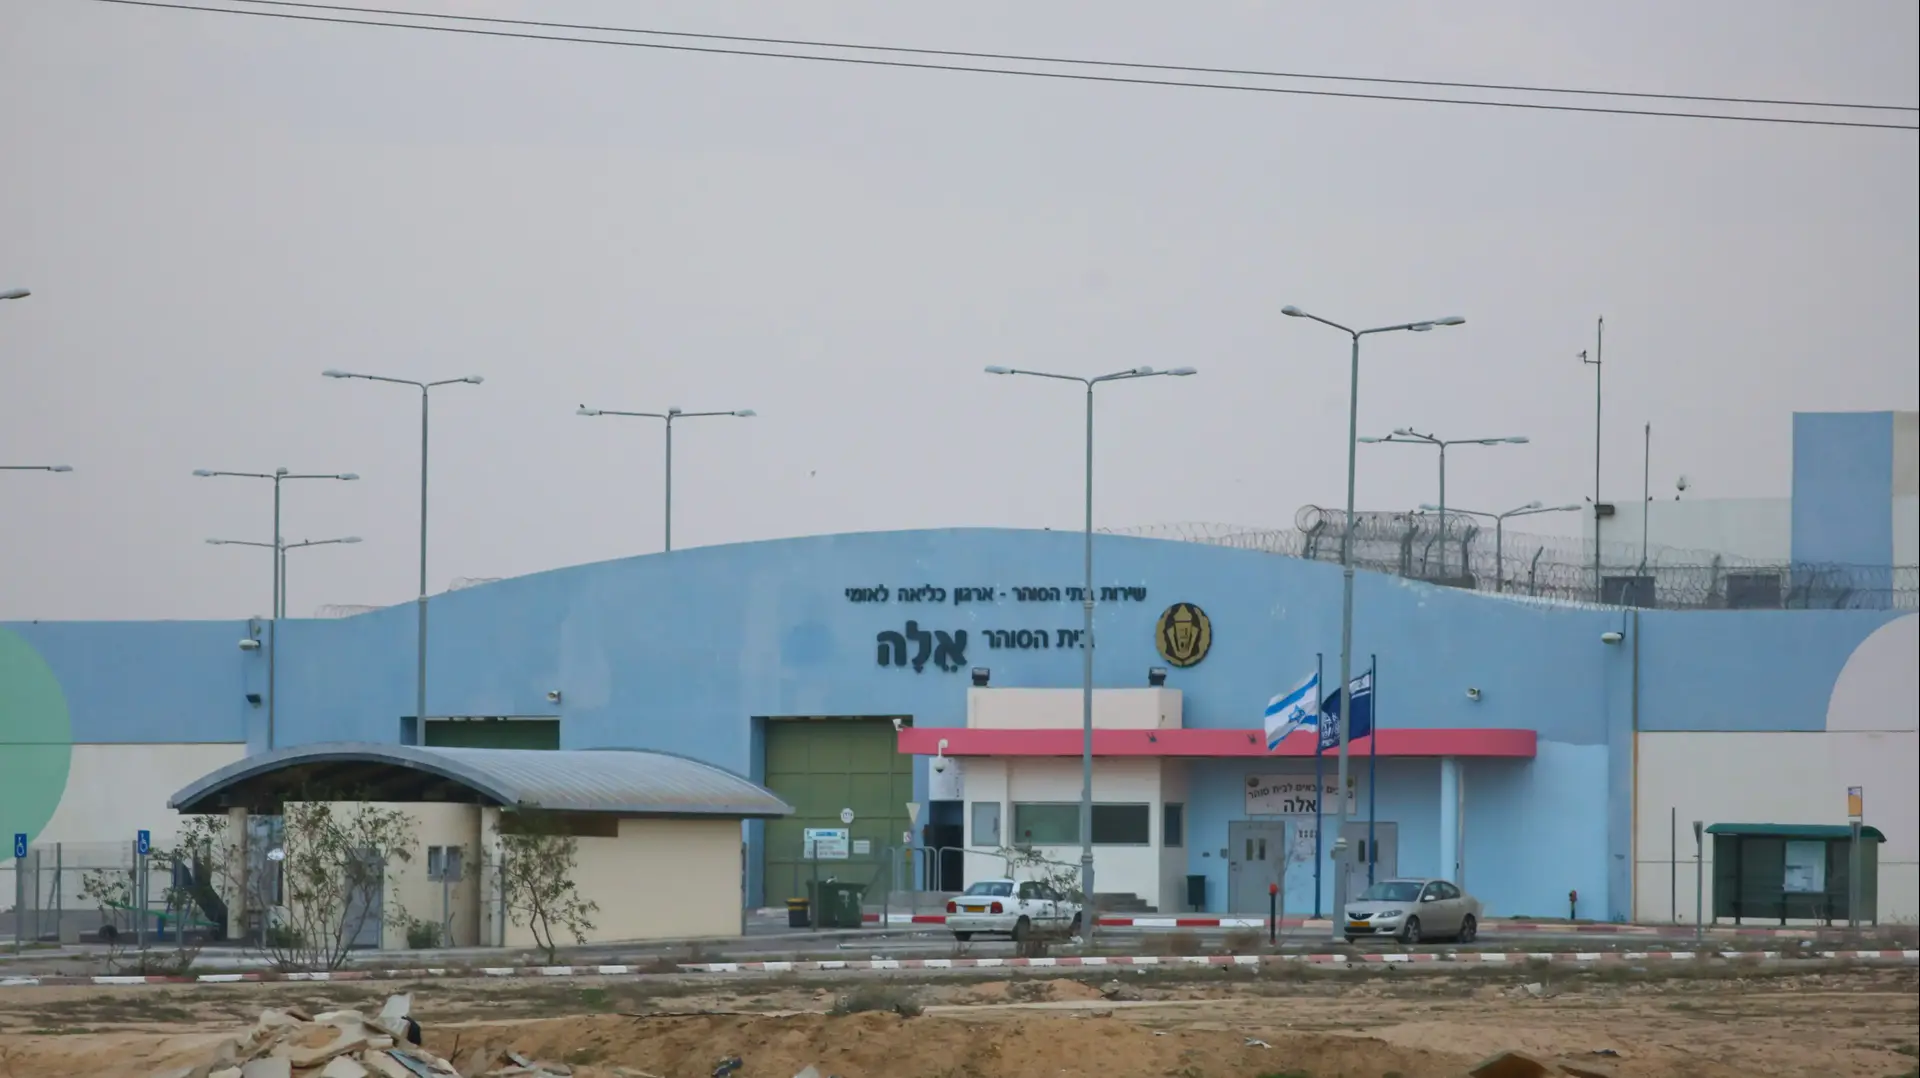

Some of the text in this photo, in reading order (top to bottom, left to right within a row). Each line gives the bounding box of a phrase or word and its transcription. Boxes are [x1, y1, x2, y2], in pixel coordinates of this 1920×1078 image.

[844, 583, 890, 602] לאומי
[897, 583, 947, 602] כליאה
[953, 586, 994, 606] ארגון
[1011, 586, 1061, 602] הסוהר
[1100, 586, 1147, 602] שירות
[981, 628, 1049, 650] הסוהר
[1295, 783, 1323, 794] באים
[1283, 795, 1318, 813] אלה
